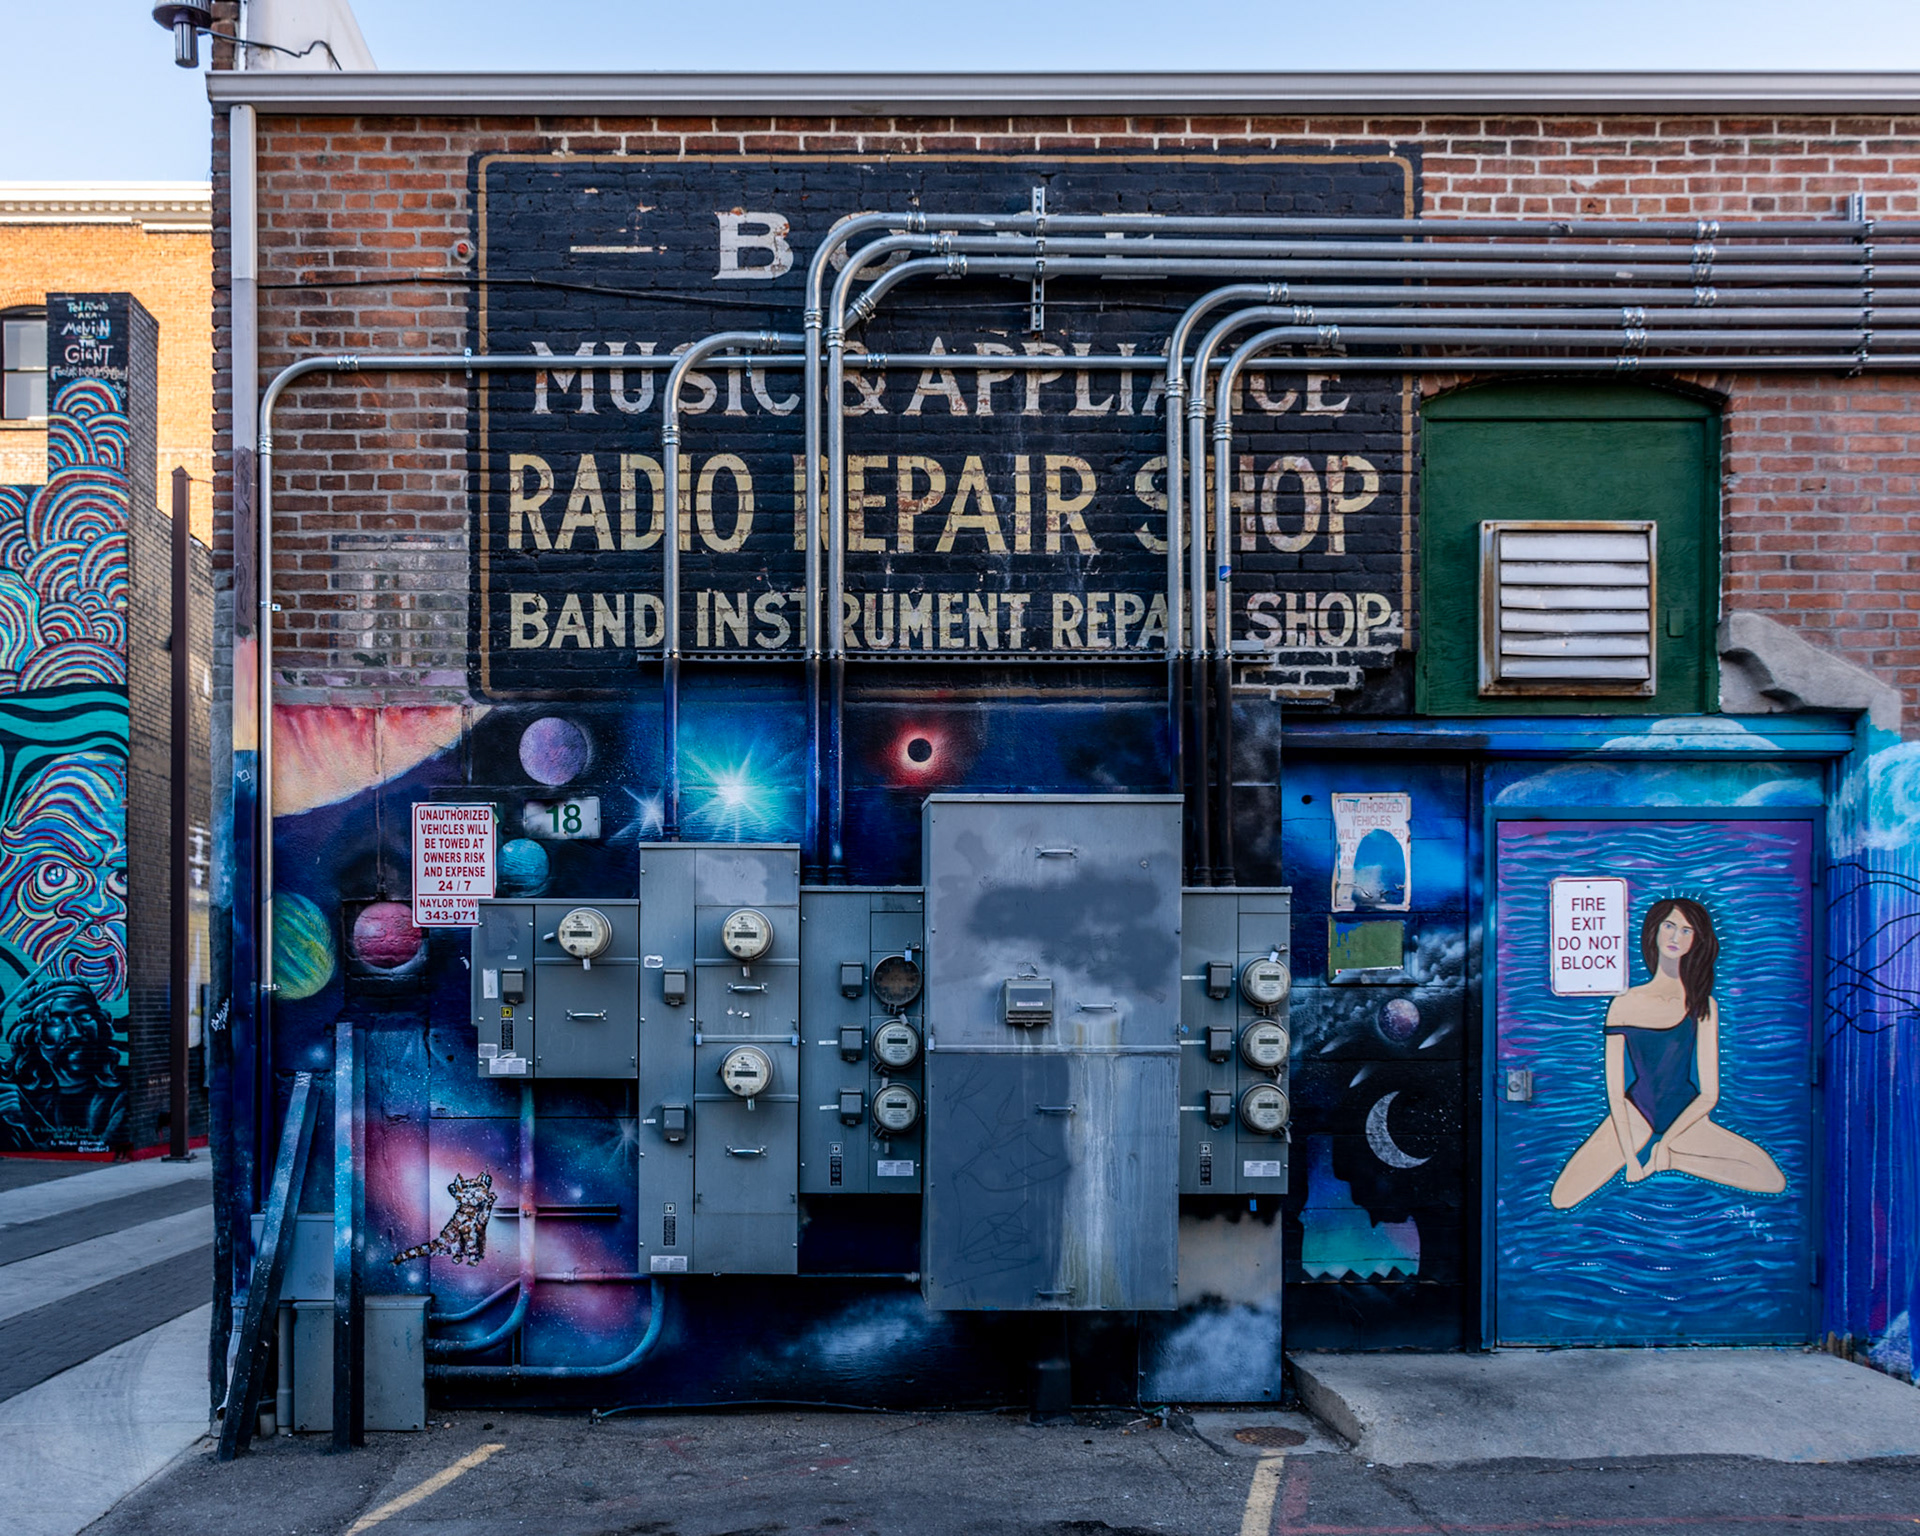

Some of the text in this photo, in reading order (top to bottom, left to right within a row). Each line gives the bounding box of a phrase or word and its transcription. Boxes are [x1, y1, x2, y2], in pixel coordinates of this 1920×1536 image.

[531, 341, 800, 416] MUSIC
[508, 453, 754, 553] RADIO
[1134, 455, 1379, 556] SHOP
[508, 592, 665, 649] BAND
[696, 592, 1030, 650] INSTRUMENT
[1246, 591, 1393, 648] SHOP
[1339, 802, 1404, 813] UNAUTHORIZED
[419, 810, 490, 821] UNAUTHORIZED
[545, 804, 582, 834] 18
[1351, 816, 1392, 827] VEHICLES
[421, 824, 488, 835] VEHICLES WILL
[1338, 829, 1357, 840] WILL
[424, 838, 484, 849] BE TOWED AT
[423, 852, 485, 863] OWNERS RISK
[423, 866, 485, 877] AND EXPENSE
[438, 880, 453, 891] 24
[464, 881, 471, 891] 7
[419, 898, 454, 908] NAYLOR
[1571, 897, 1606, 911] FIRE
[1571, 916, 1606, 931] EXIT
[1558, 935, 1621, 950] DO NOT
[1561, 955, 1617, 970] BLOCK
